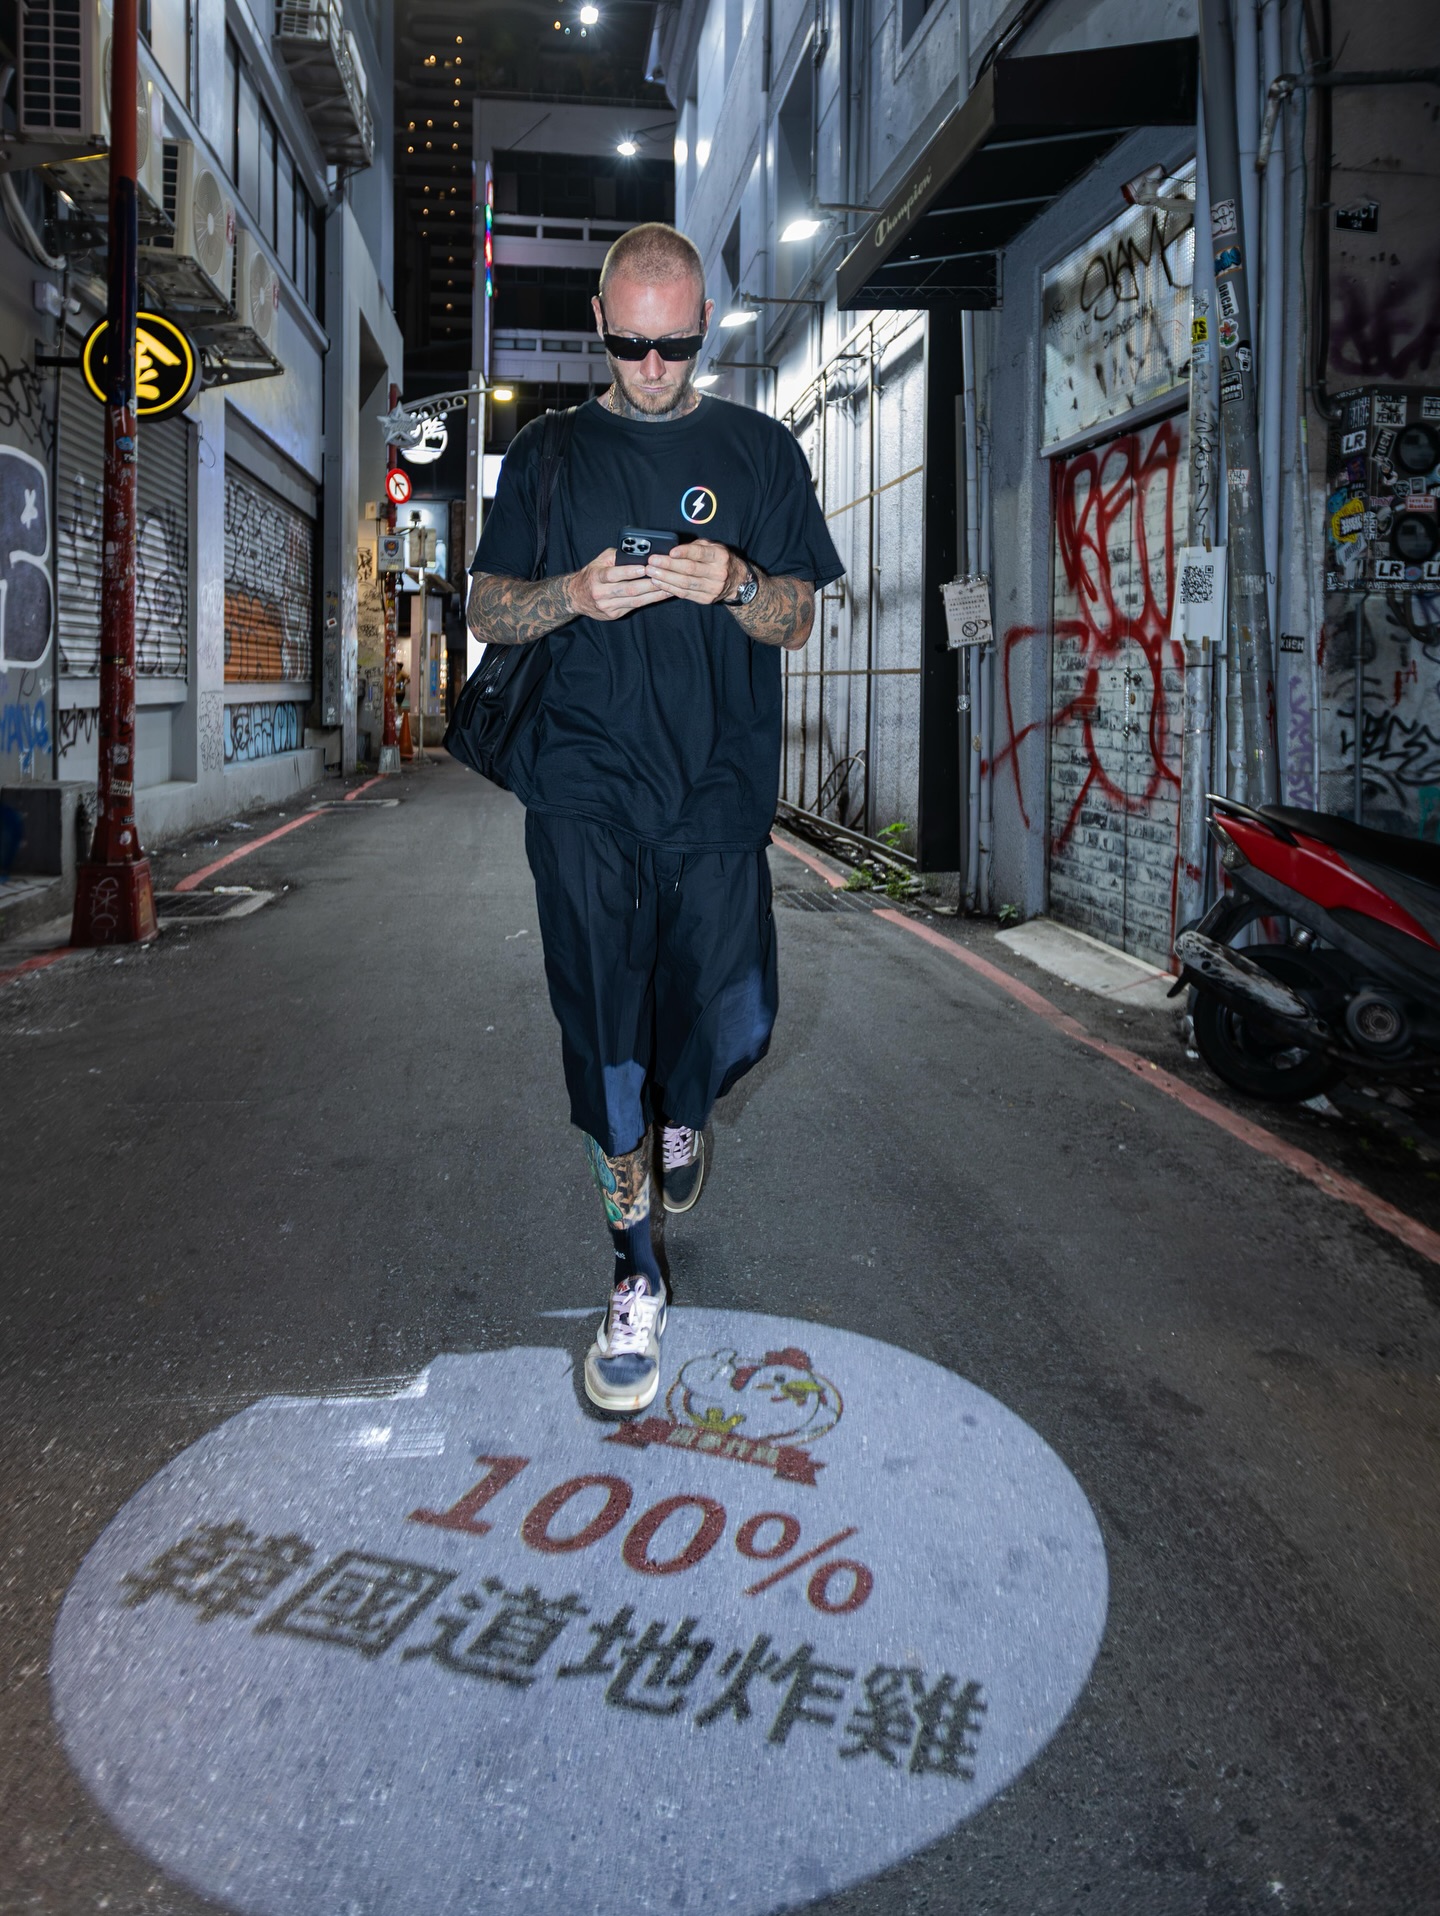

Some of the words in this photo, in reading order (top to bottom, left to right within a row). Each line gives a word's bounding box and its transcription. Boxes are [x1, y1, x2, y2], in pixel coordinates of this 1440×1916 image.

[874, 170, 933, 248] Champion
[1218, 284, 1235, 317] ORCAS
[1346, 434, 1364, 450] LR
[1378, 562, 1403, 577] LR
[410, 1451, 876, 1617] 100%
[118, 1515, 990, 1782] 韓國道地炸雞
